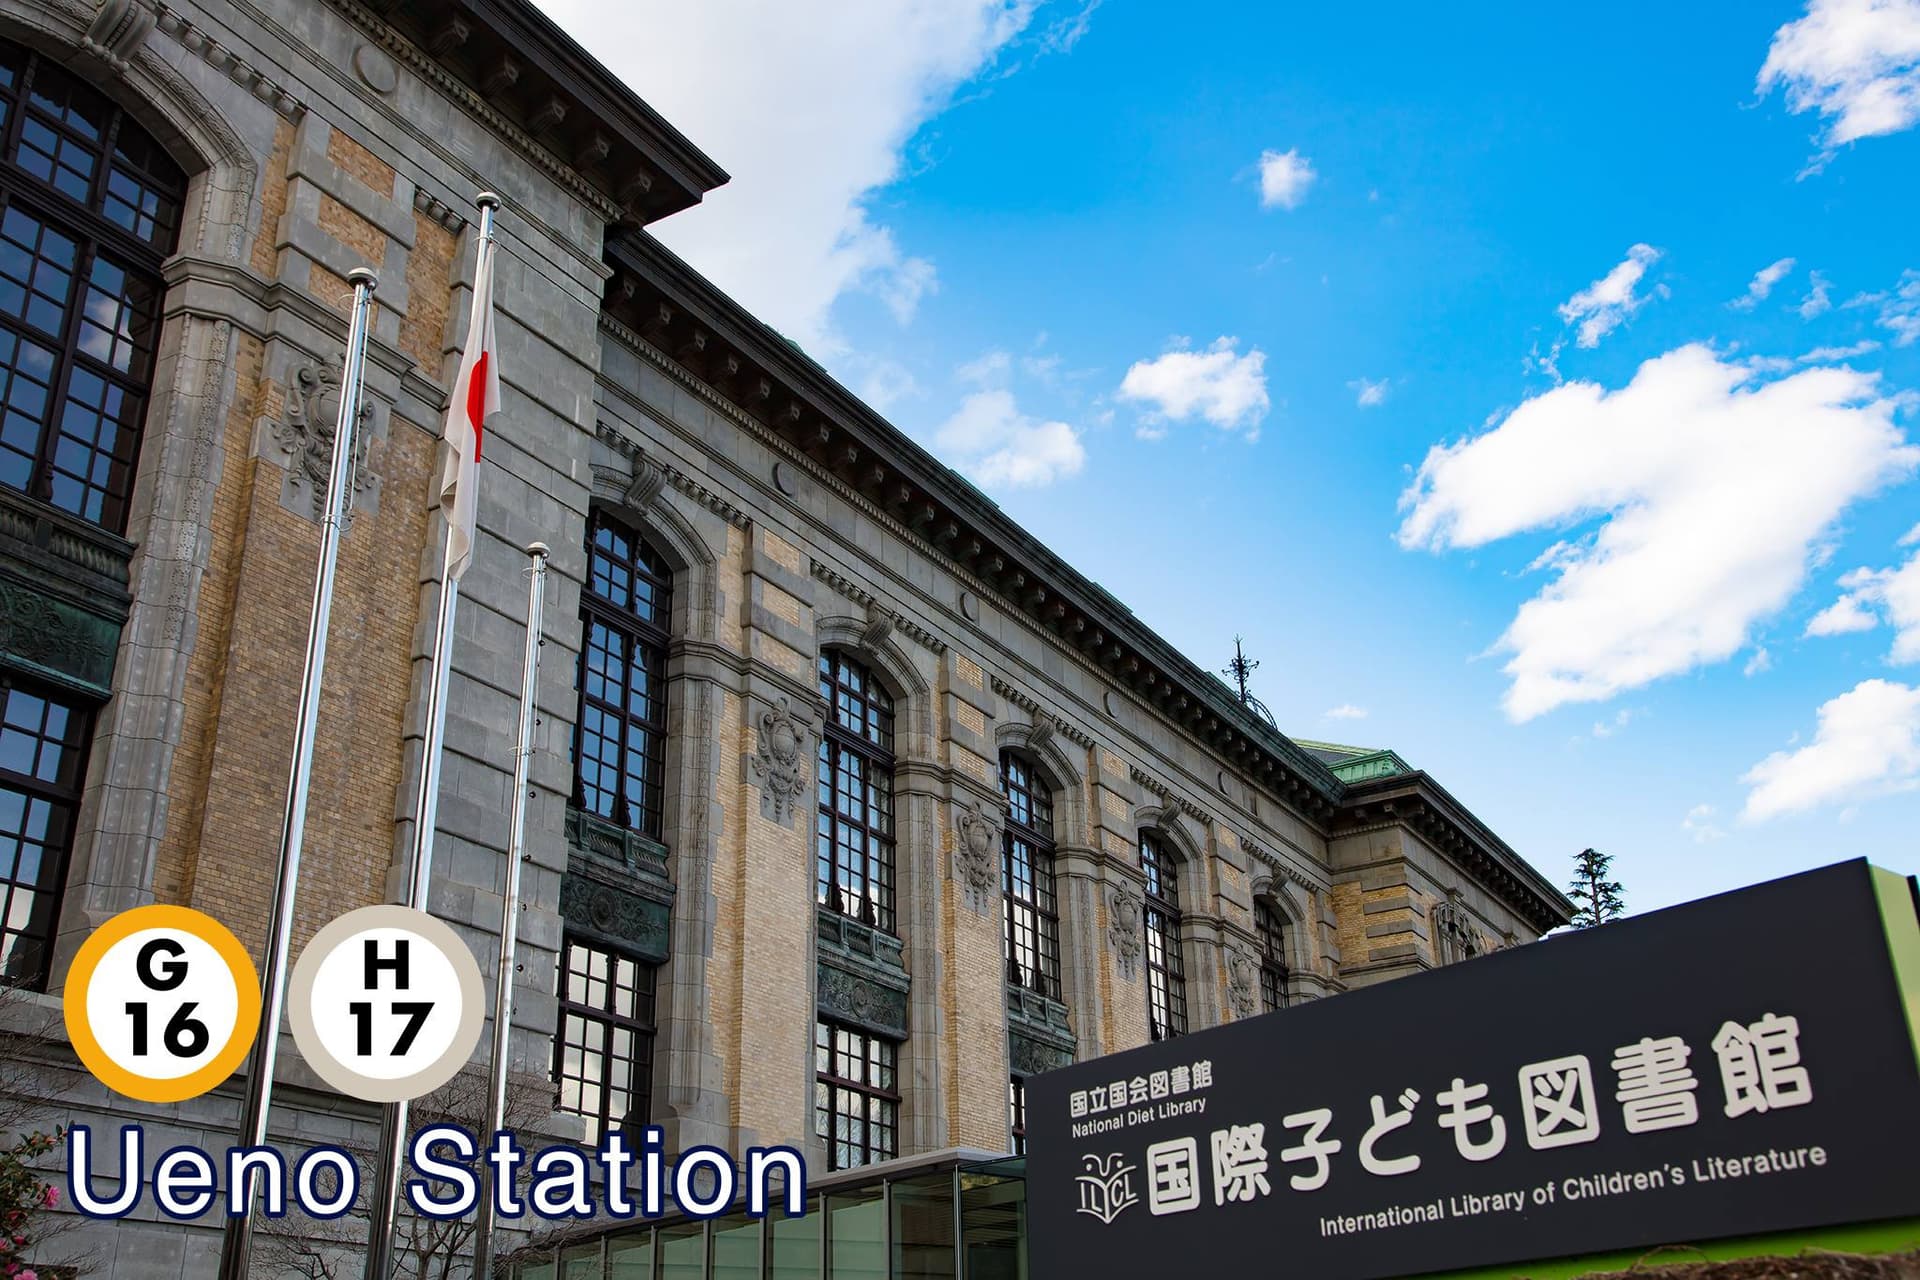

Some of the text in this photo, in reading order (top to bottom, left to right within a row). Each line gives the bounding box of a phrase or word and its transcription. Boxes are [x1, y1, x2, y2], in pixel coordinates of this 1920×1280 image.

[1070, 1059, 1213, 1118] 国立国会図書館
[1072, 1097, 1207, 1139] National Diet Library
[1146, 1011, 1813, 1216] 国際子ども図書館
[1320, 1146, 1827, 1237] International Library of Children's Literature
